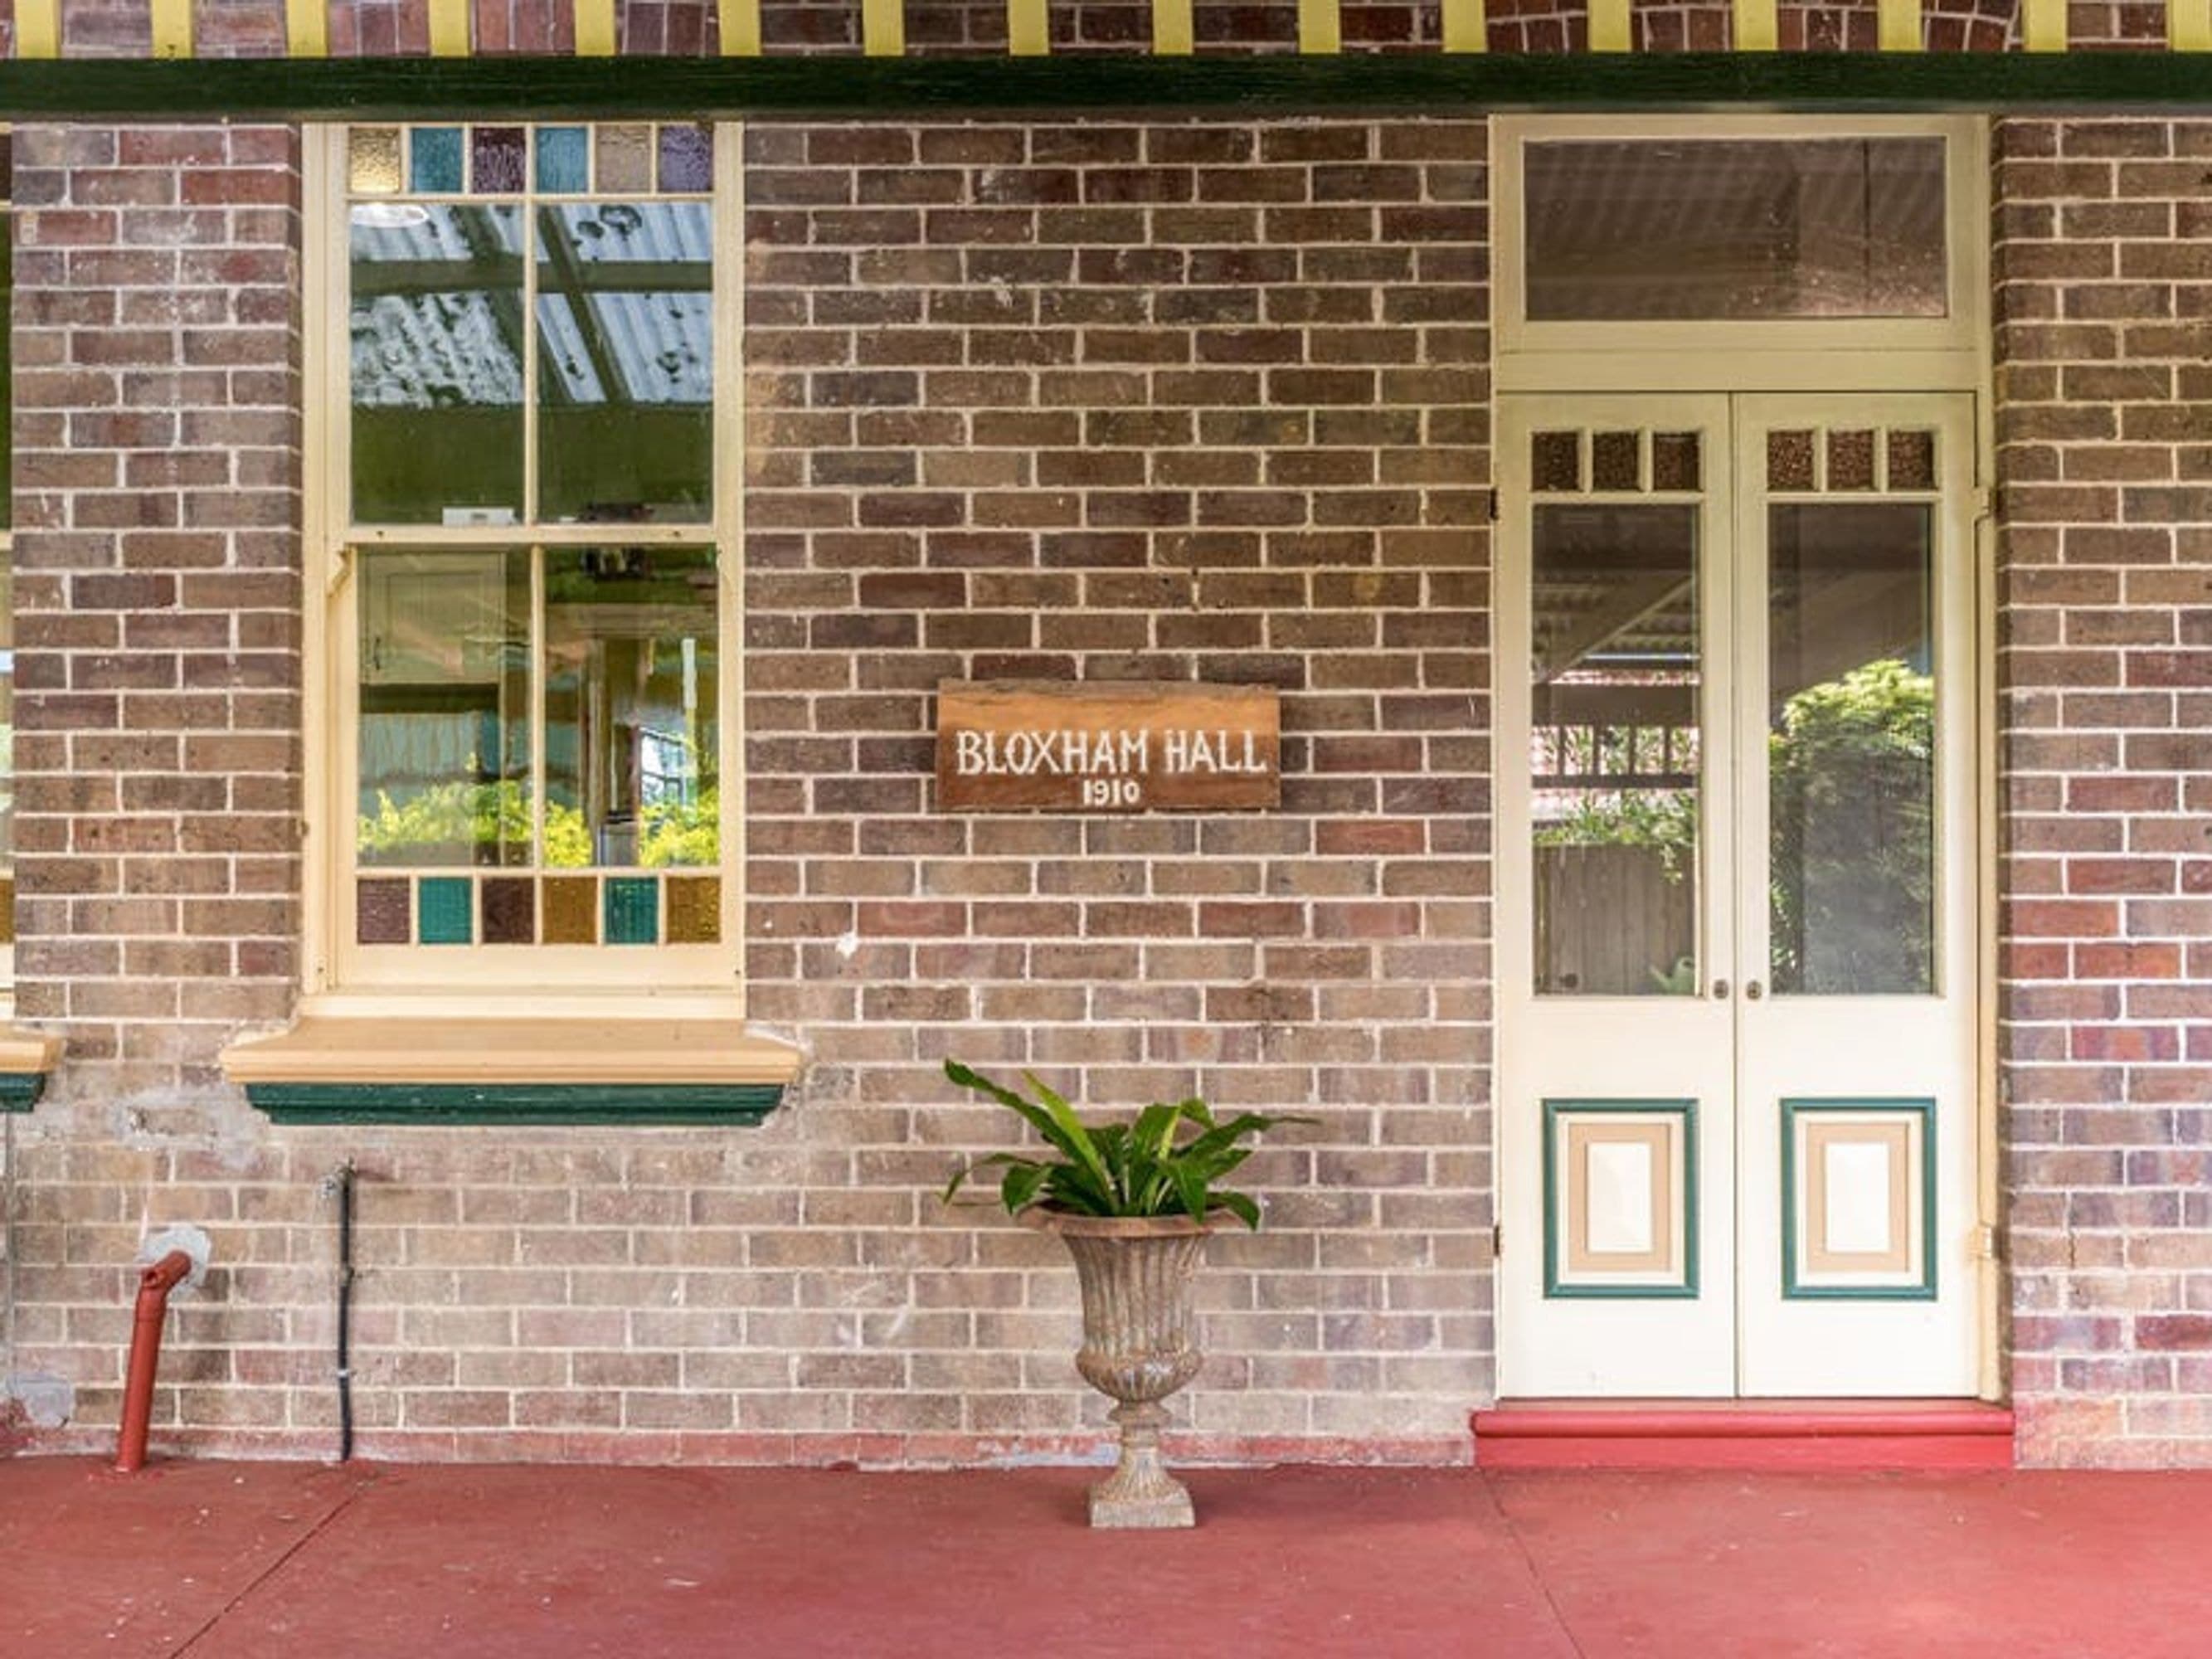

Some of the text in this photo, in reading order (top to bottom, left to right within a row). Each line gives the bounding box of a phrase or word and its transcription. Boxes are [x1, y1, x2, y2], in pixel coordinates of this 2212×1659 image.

[955, 728, 1266, 776] BLOXHAM HALL
[1082, 778, 1141, 806] 1910
